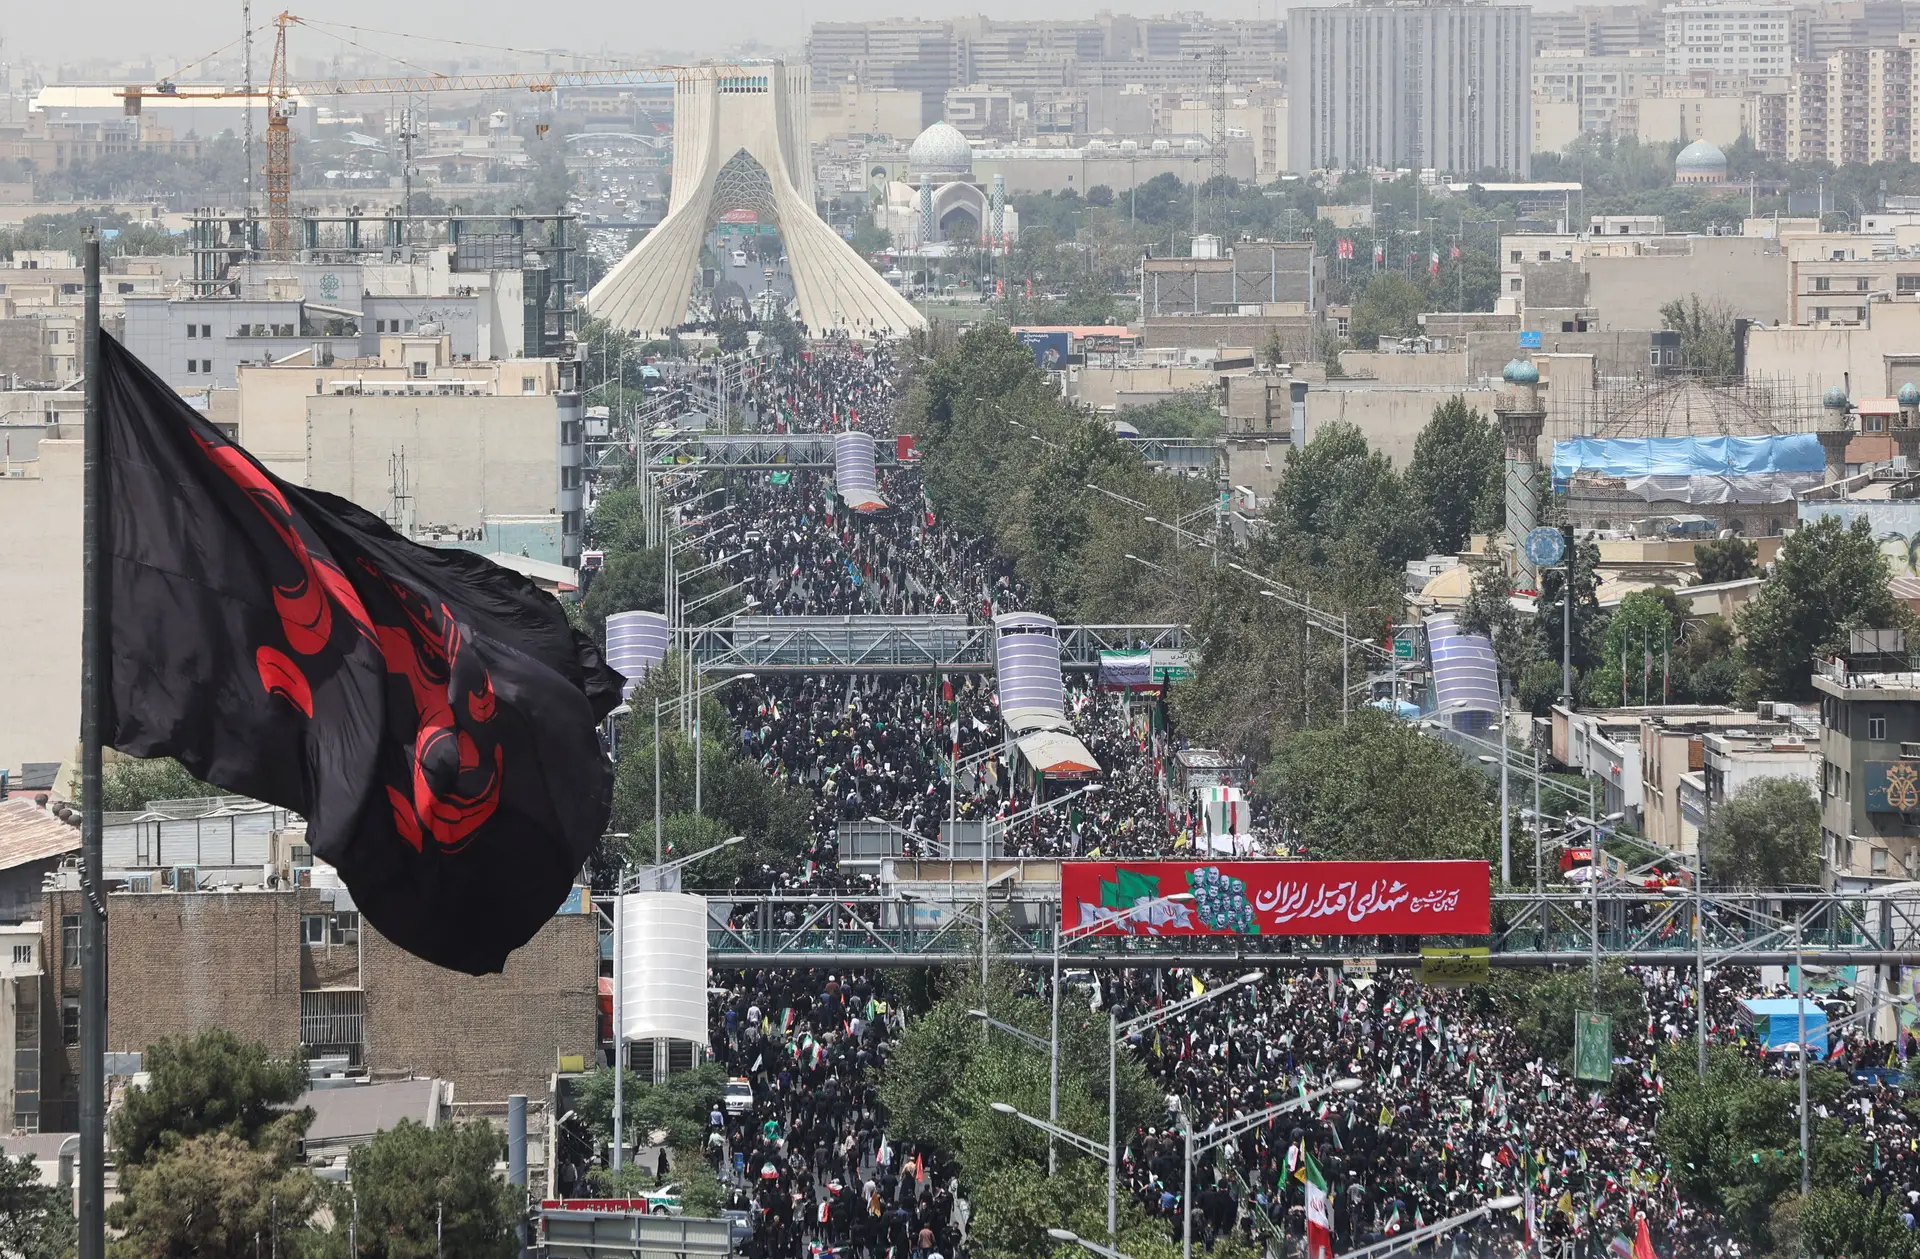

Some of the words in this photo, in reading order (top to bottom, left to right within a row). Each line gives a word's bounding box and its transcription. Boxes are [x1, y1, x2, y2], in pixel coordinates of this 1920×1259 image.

[1255, 881, 1308, 923] ایران
[1297, 881, 1358, 918] اقتدار
[1347, 879, 1409, 922] شهدای
[1410, 889, 1447, 913] تشییع
[1433, 888, 1460, 912] آیین
